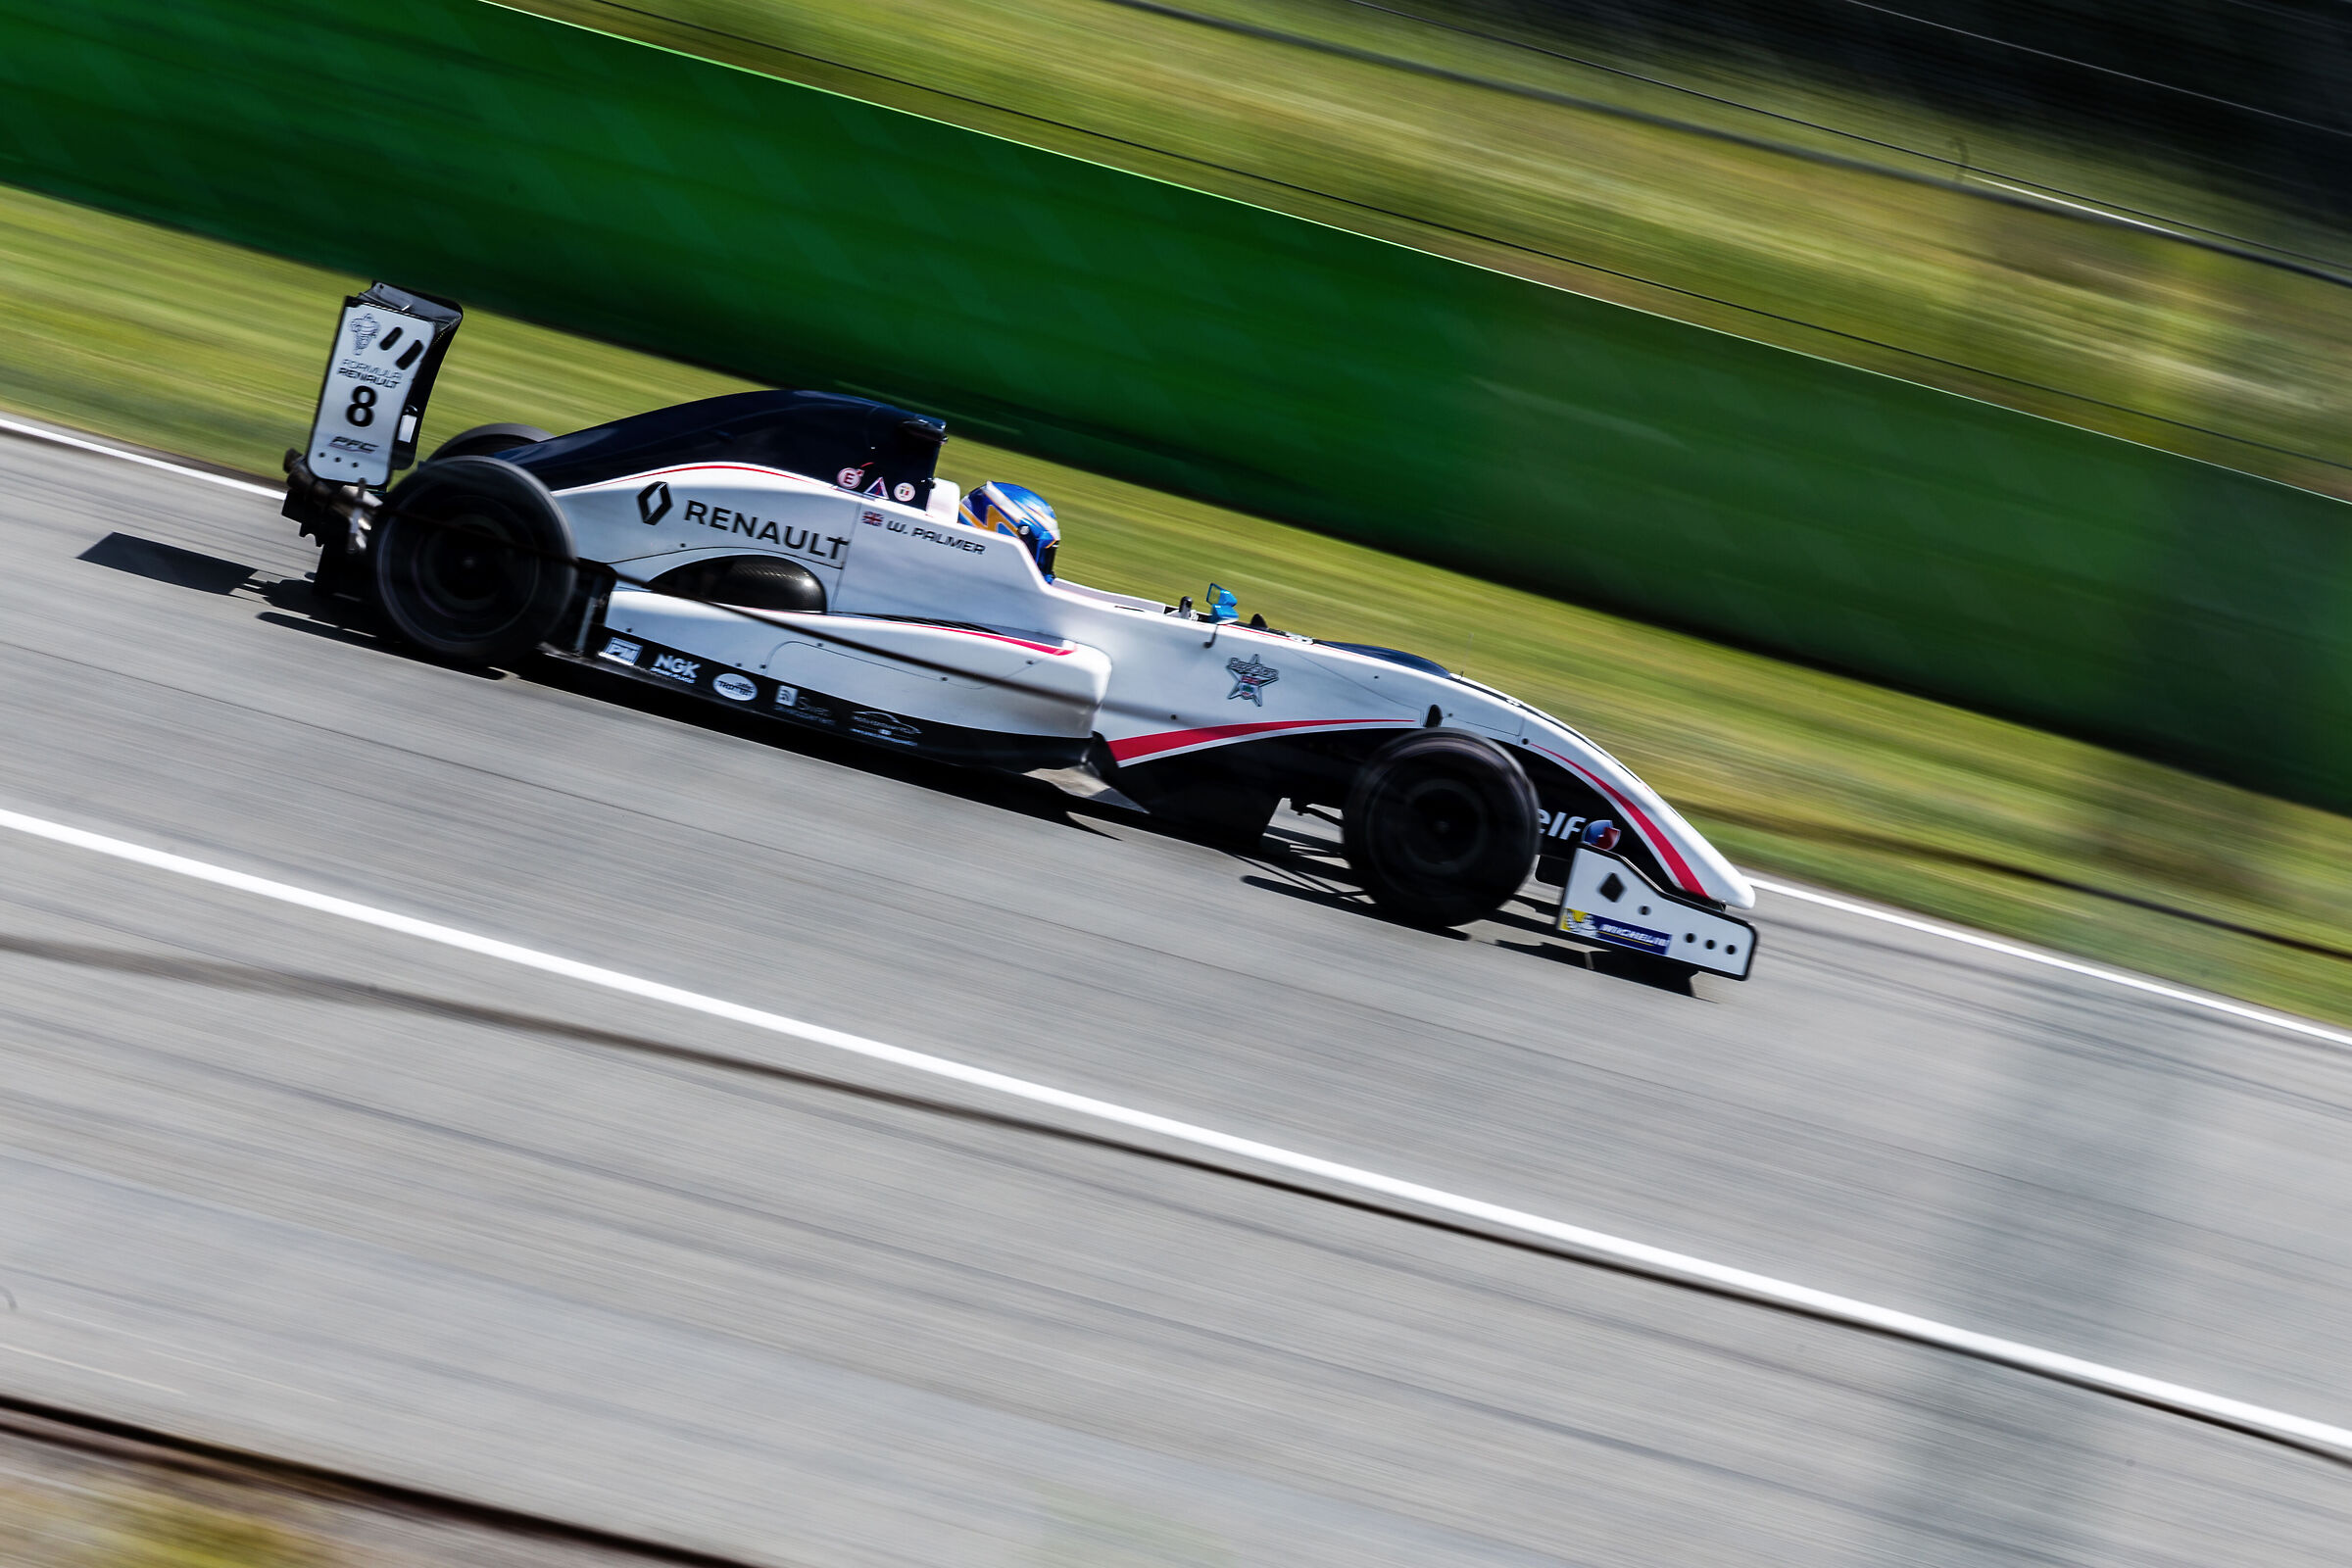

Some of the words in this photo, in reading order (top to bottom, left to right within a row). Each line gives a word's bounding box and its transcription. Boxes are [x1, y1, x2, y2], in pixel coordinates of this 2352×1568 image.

[337, 368, 400, 389] RENAULT
[343, 359, 402, 379] FORMULA
[346, 385, 378, 427] 8
[683, 500, 850, 560] RENAULT
[910, 527, 986, 555] PALMER
[653, 654, 702, 678] NGK
[1537, 808, 1587, 841] elf
[1598, 923, 1670, 947] MICHELIN
